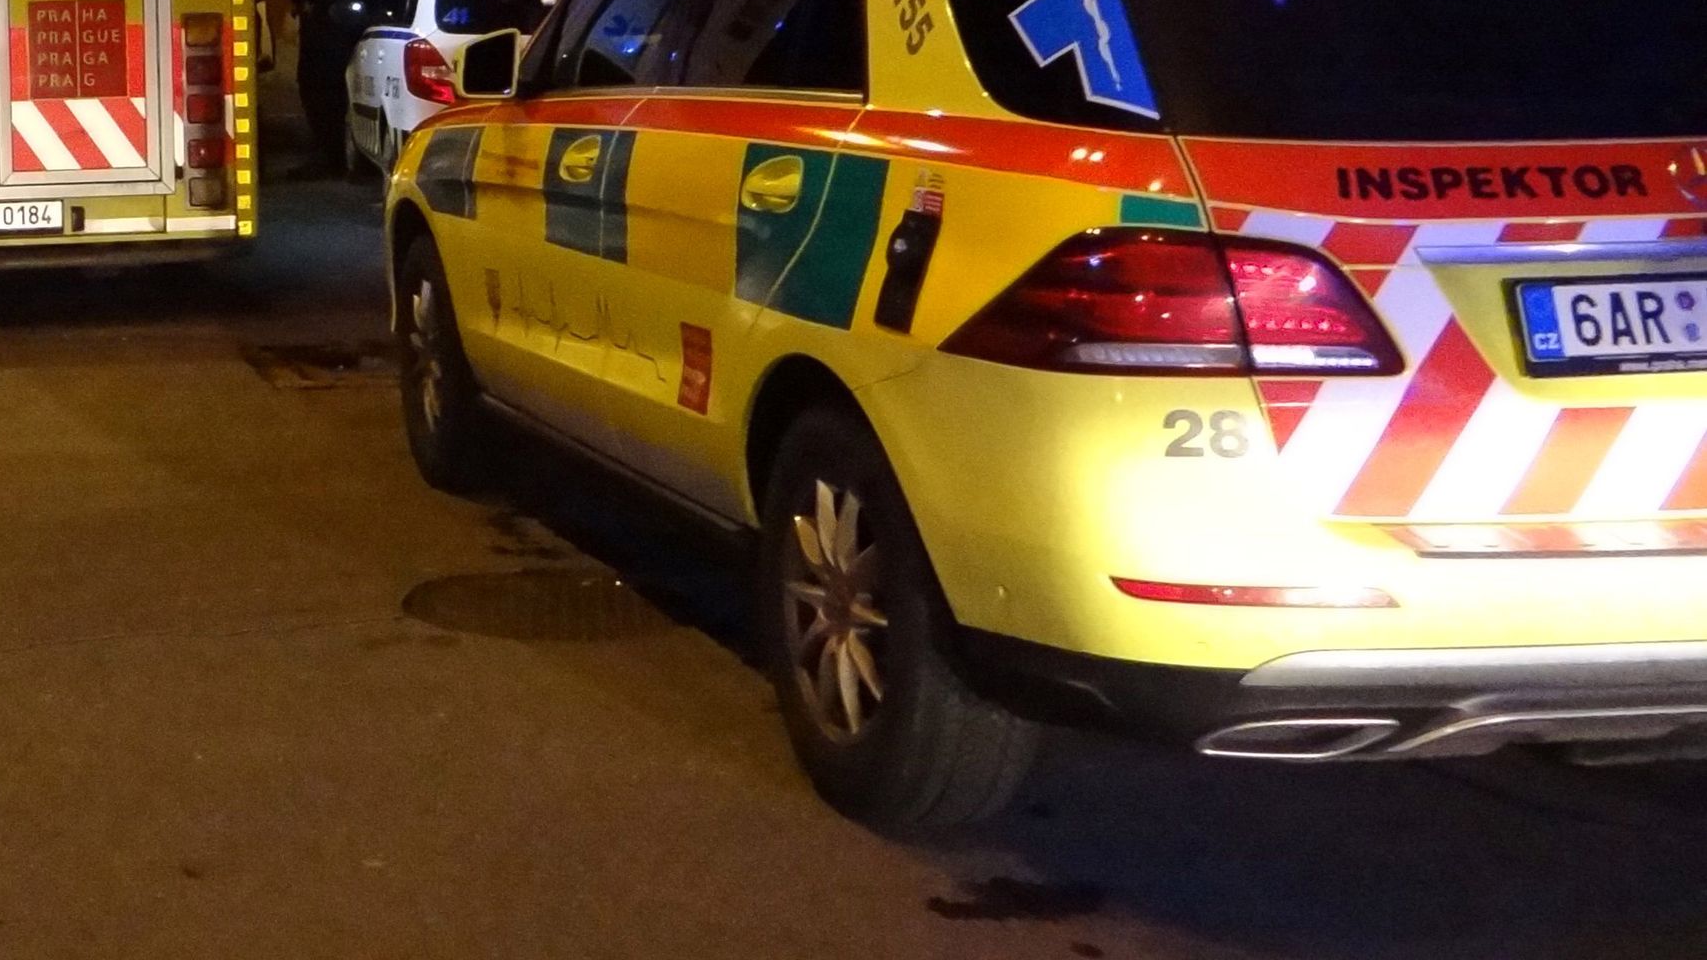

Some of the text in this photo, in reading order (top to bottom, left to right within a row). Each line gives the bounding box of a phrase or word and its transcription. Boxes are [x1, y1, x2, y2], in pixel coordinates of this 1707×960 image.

[1336, 164, 1649, 201] INSPEKTOR
[2, 204, 52, 226] 0184
[1570, 290, 1672, 347] 6AR
[1532, 331, 1561, 351] CZ
[1162, 408, 1250, 459] 28
